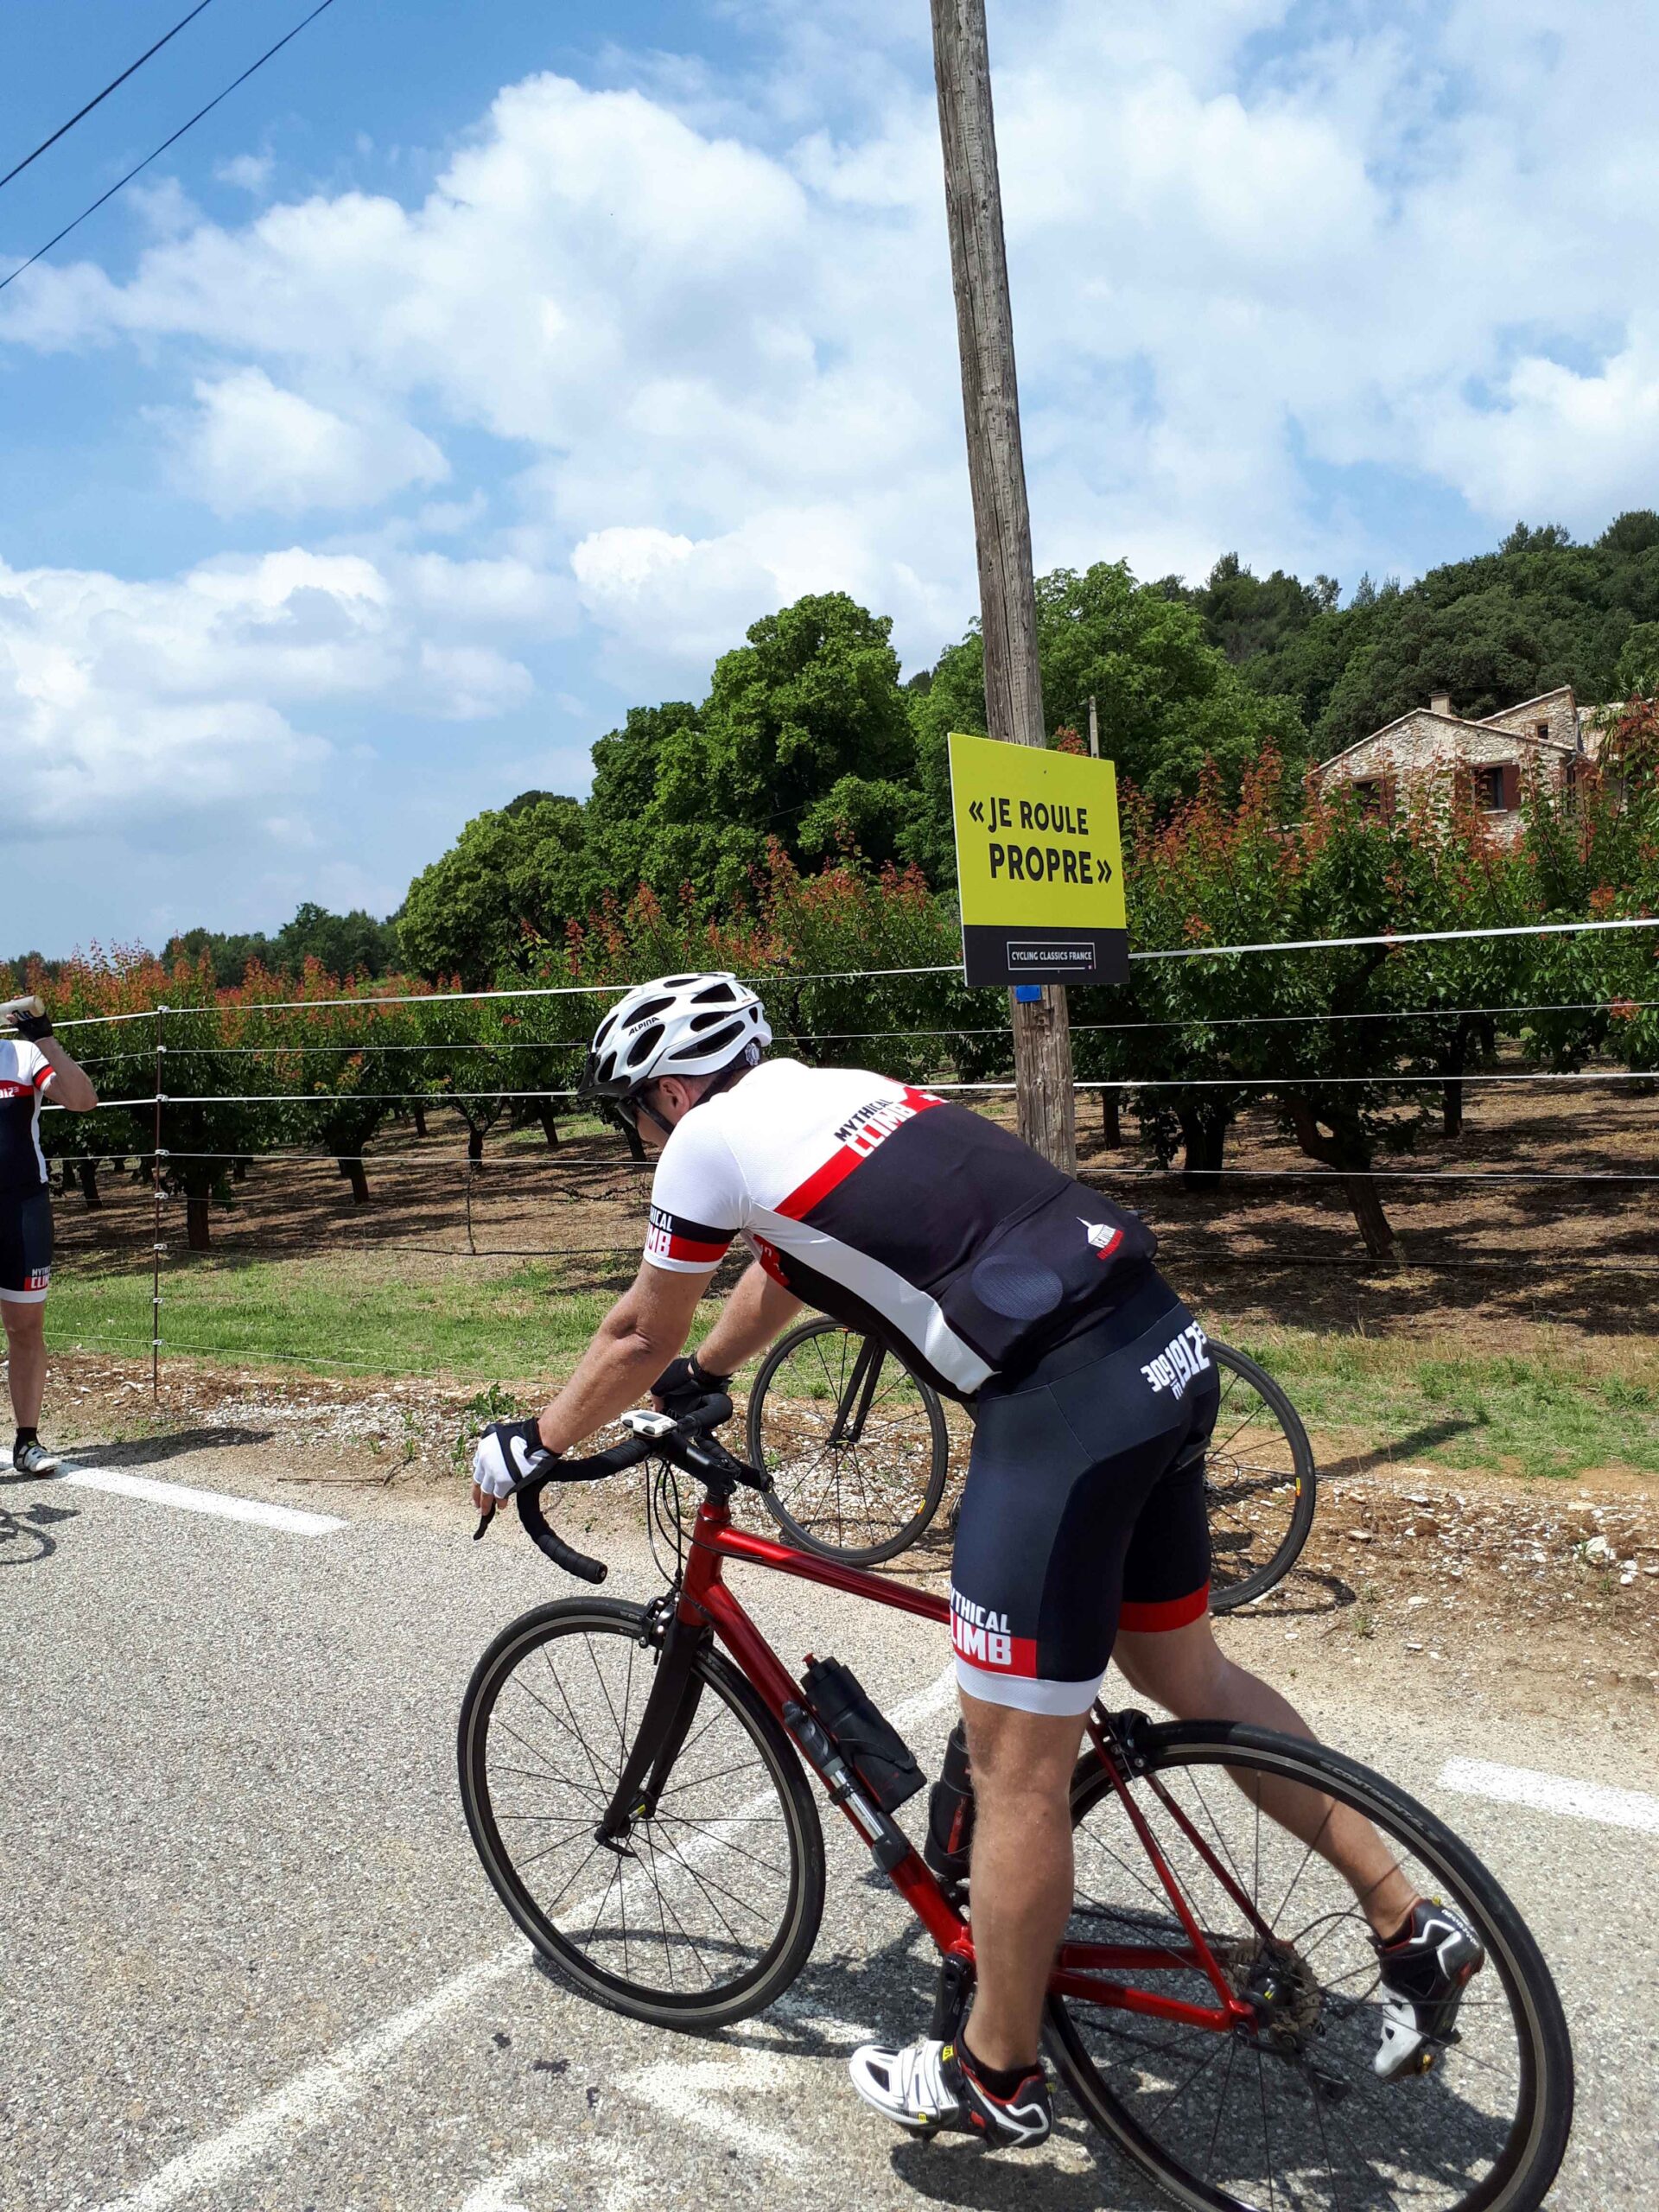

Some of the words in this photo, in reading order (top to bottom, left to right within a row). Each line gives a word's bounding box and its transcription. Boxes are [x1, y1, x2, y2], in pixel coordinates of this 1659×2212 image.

[1020, 800, 1089, 835] ROULE
[1011, 951, 1039, 961] CYCLING
[1039, 951, 1068, 961] CLASSICS
[1069, 951, 1093, 961] FRANCE
[628, 1016, 660, 1037] ALPINA
[833, 1097, 894, 1143] MYTHICAL
[845, 1102, 918, 1158] CLIMB
[949, 1583, 1012, 1634] YTHICAL
[949, 1607, 1013, 1666] LIMB
